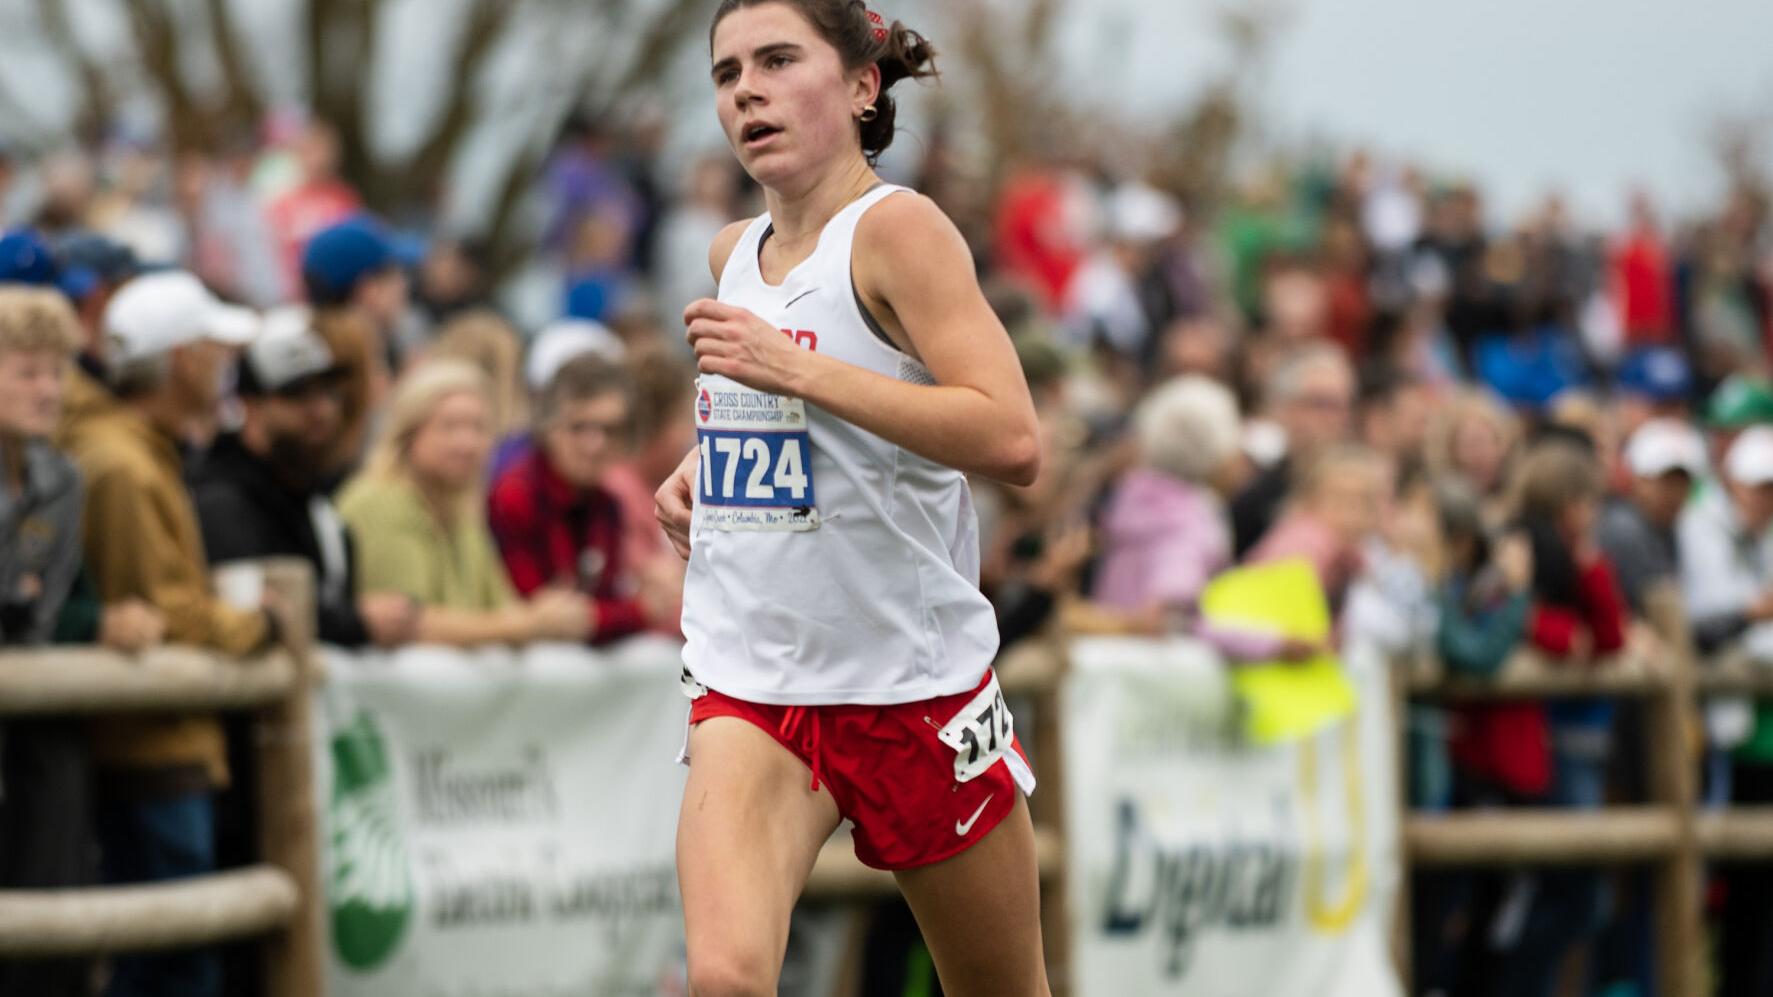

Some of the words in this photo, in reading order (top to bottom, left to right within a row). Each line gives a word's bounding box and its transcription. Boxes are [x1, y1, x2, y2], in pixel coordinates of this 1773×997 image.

[713, 392, 739, 408] CROSS
[740, 392, 780, 409] COUNTRY
[713, 409, 731, 421] STATE
[733, 410, 784, 423] CHAMPIONSHIP
[700, 435, 808, 499] 1724
[959, 689, 1009, 765] 172
